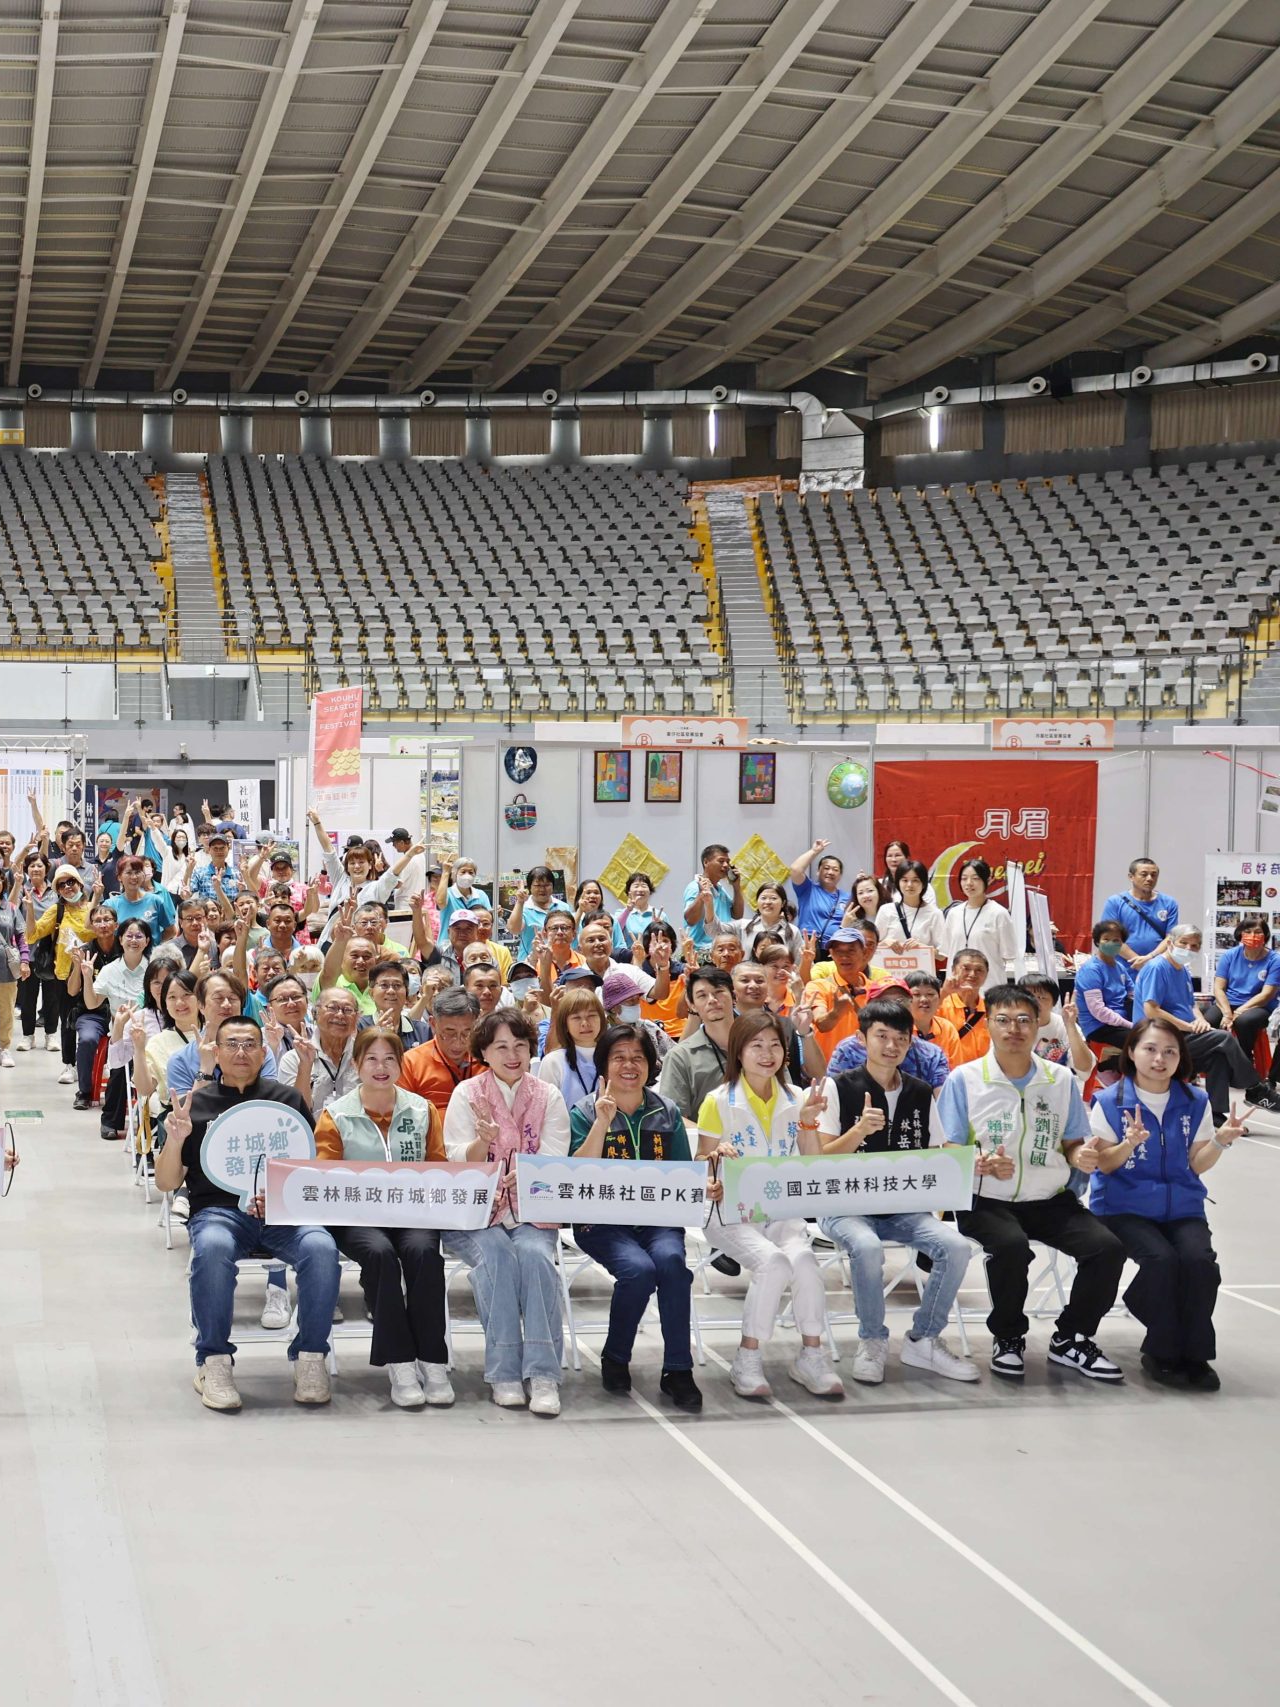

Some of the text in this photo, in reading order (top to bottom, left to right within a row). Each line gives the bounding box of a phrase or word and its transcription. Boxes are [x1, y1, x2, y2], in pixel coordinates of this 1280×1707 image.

[324, 702, 360, 712] SEASIDE
[331, 693, 360, 703] KOUHU
[320, 720, 358, 729] FESTIVAL
[640, 735, 649, 745] B
[1010, 738, 1018, 747] B
[975, 808, 1050, 839] 月眉
[226, 1130, 289, 1153] #城鄉
[1030, 1117, 1051, 1167] 劉建國
[301, 1185, 489, 1206] 雲林縣政府城鄉發展
[557, 1182, 705, 1205] 雲林縣社區PK賽
[786, 1174, 938, 1197] 國立雲林科技大學
